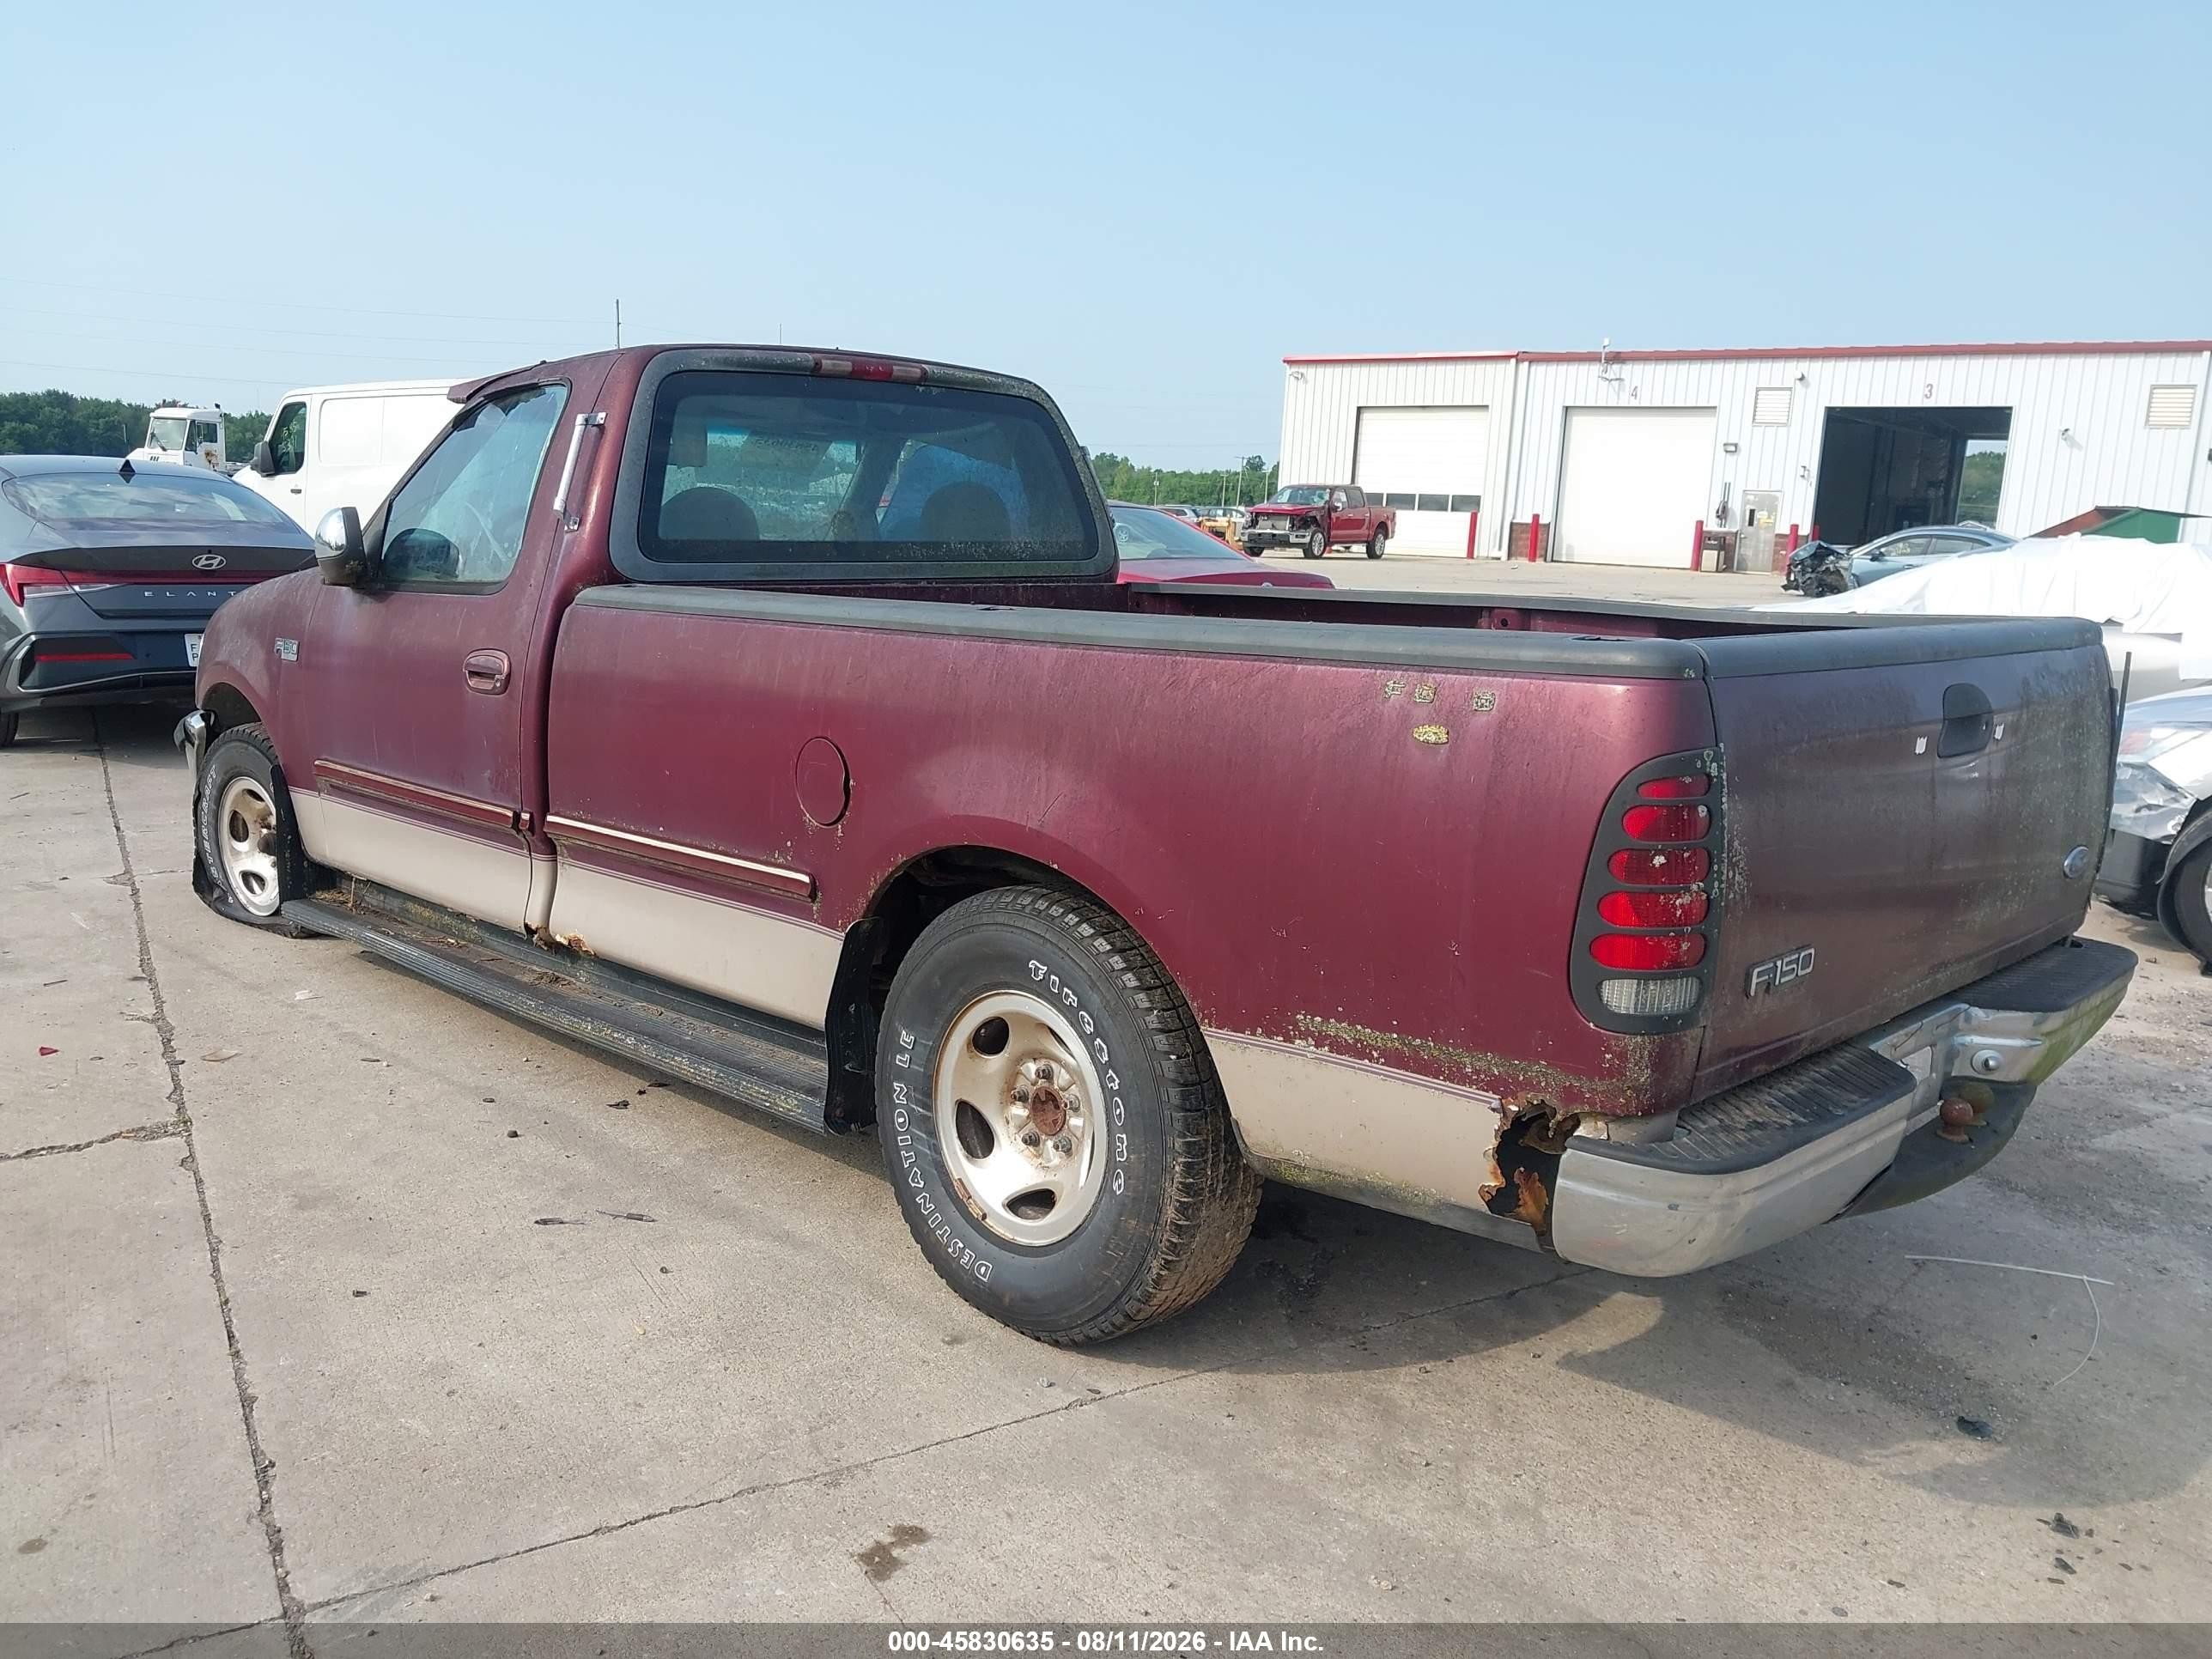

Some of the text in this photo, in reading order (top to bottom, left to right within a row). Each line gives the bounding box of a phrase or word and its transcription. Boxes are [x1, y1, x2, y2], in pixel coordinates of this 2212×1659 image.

[1631, 386, 1638, 400] 4
[1924, 383, 1933, 399] 3
[1029, 959, 1127, 1195] Firestone
[893, 1030, 994, 1282] DESTINATION LE
